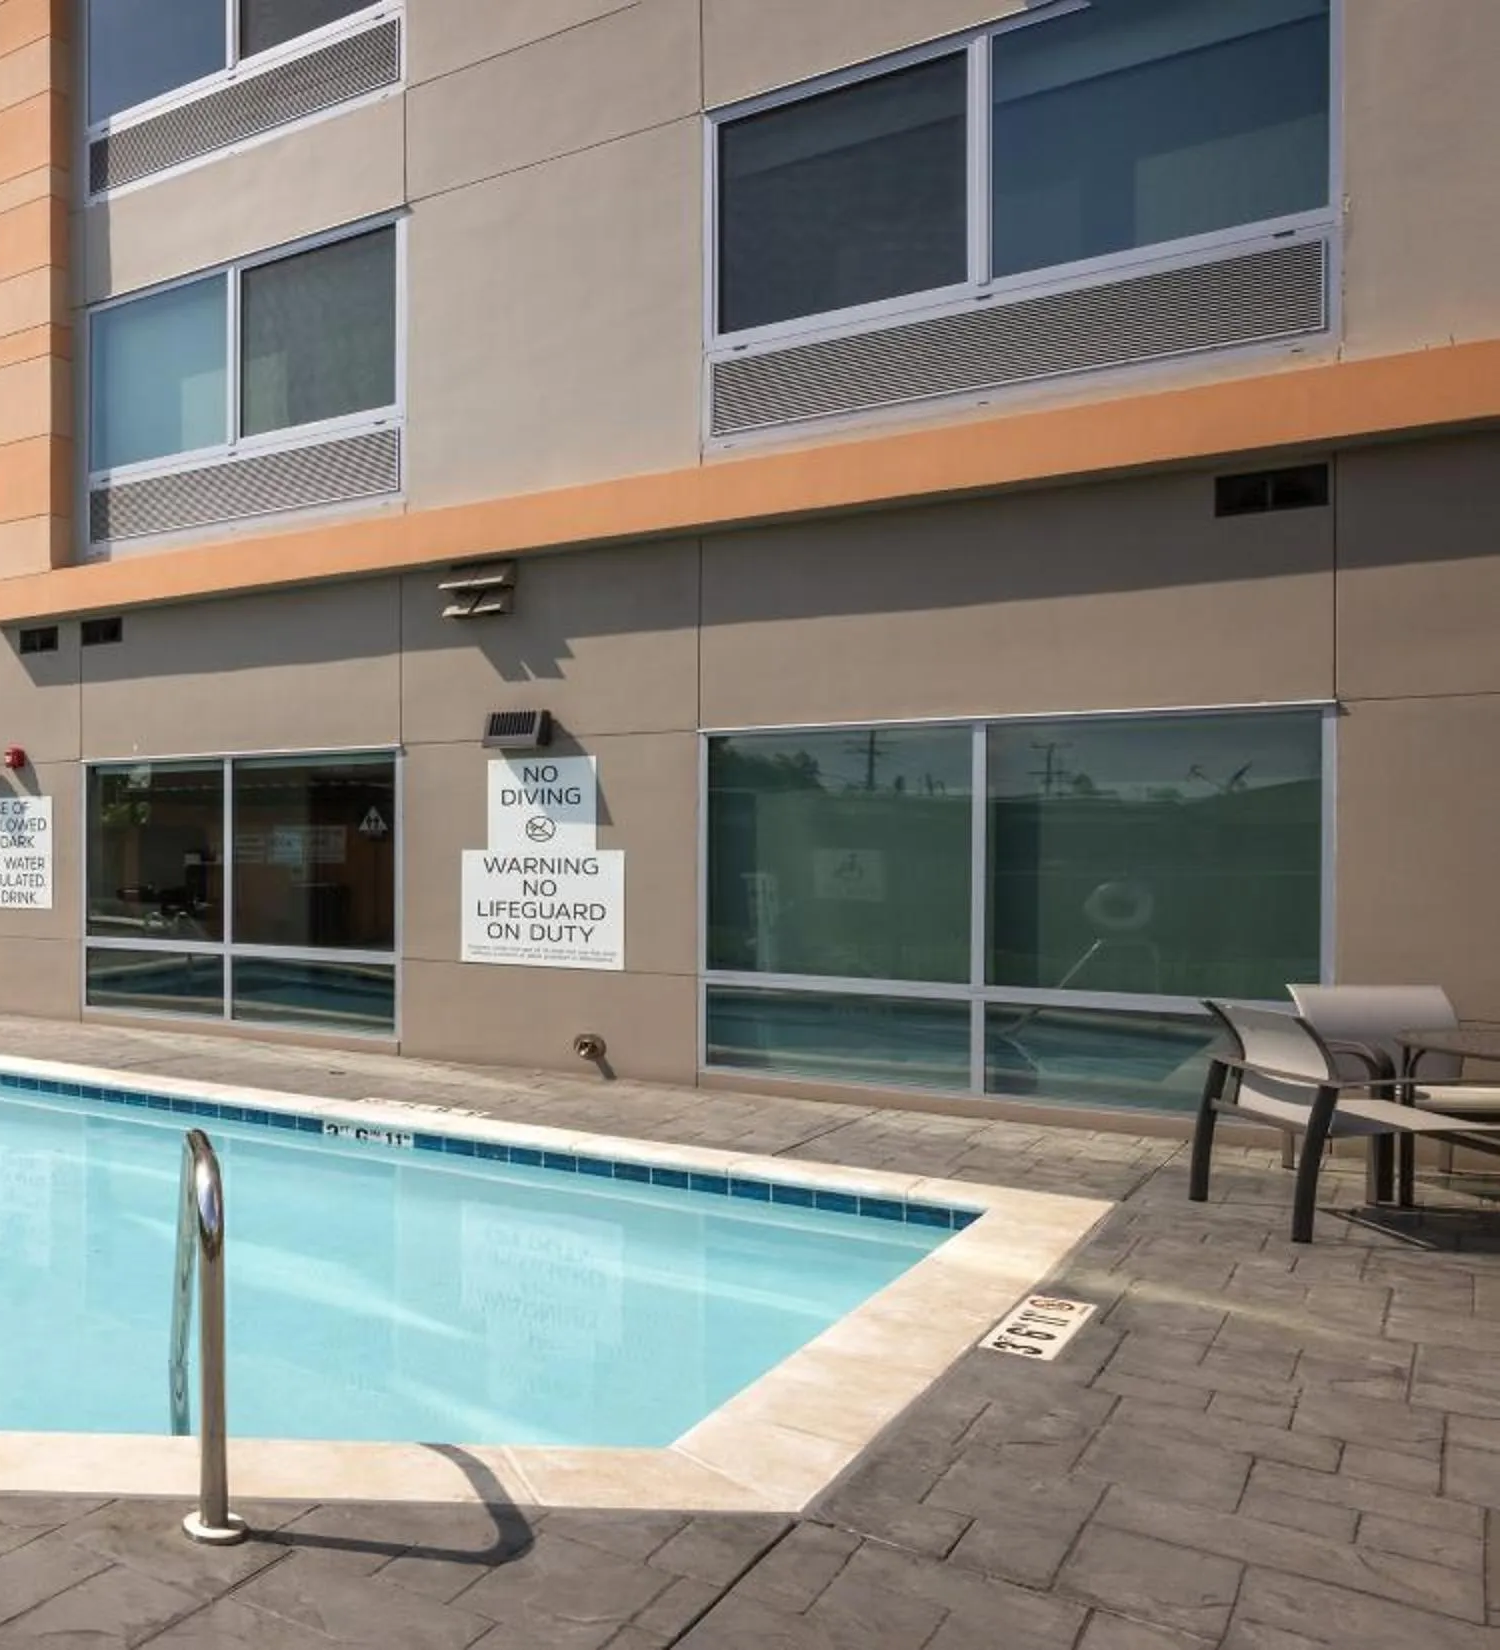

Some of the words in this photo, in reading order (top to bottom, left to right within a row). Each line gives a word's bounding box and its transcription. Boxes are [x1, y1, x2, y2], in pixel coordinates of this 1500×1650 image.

[522, 765, 559, 783] NO
[501, 787, 582, 807] DIVING
[12, 801, 31, 814] OF
[0, 835, 36, 849] DARK
[5, 857, 46, 870] WATER
[484, 857, 600, 876] WARNING
[522, 880, 558, 897] NO
[477, 901, 607, 921] LIFEGUARD
[487, 922, 520, 940] ON
[530, 924, 596, 943] DUTY
